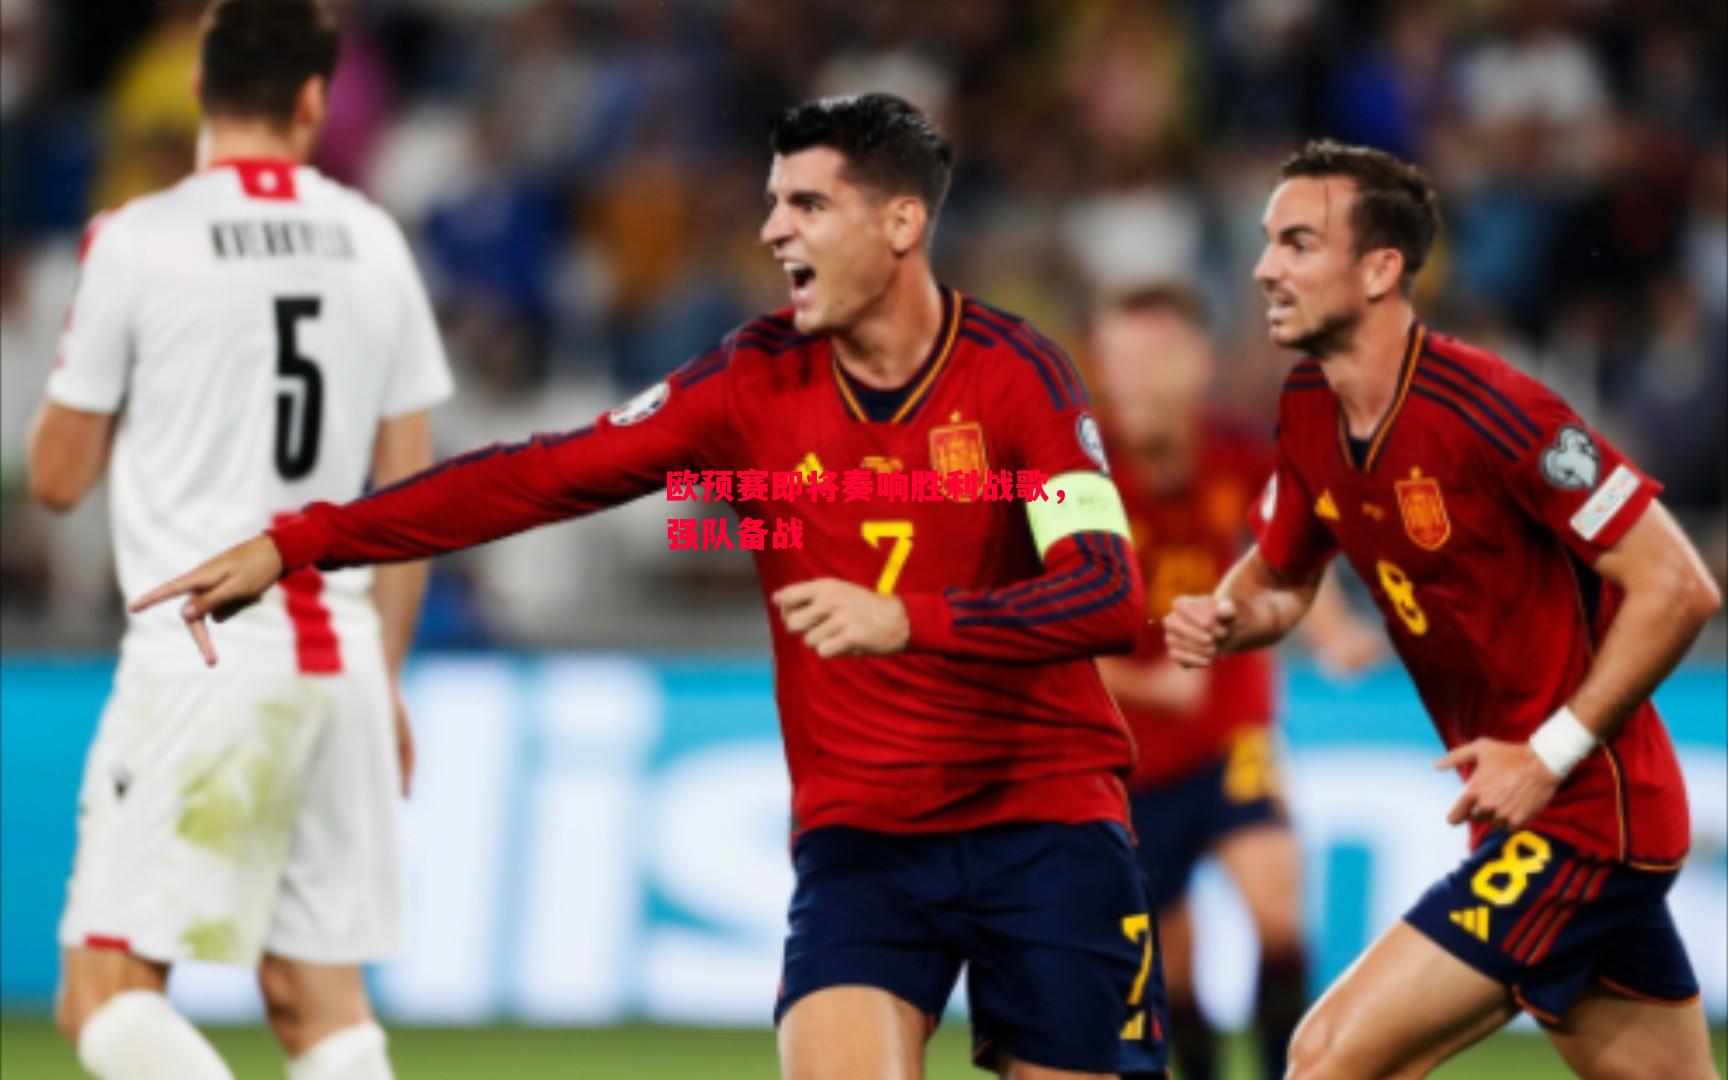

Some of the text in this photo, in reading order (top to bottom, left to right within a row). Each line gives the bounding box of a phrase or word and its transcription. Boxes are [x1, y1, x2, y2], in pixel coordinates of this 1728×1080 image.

[273, 296, 323, 483] 5
[861, 521, 914, 596] 7
[1376, 559, 1429, 637] 8
[1470, 829, 1552, 906] 8
[1121, 913, 1150, 1006] 7
